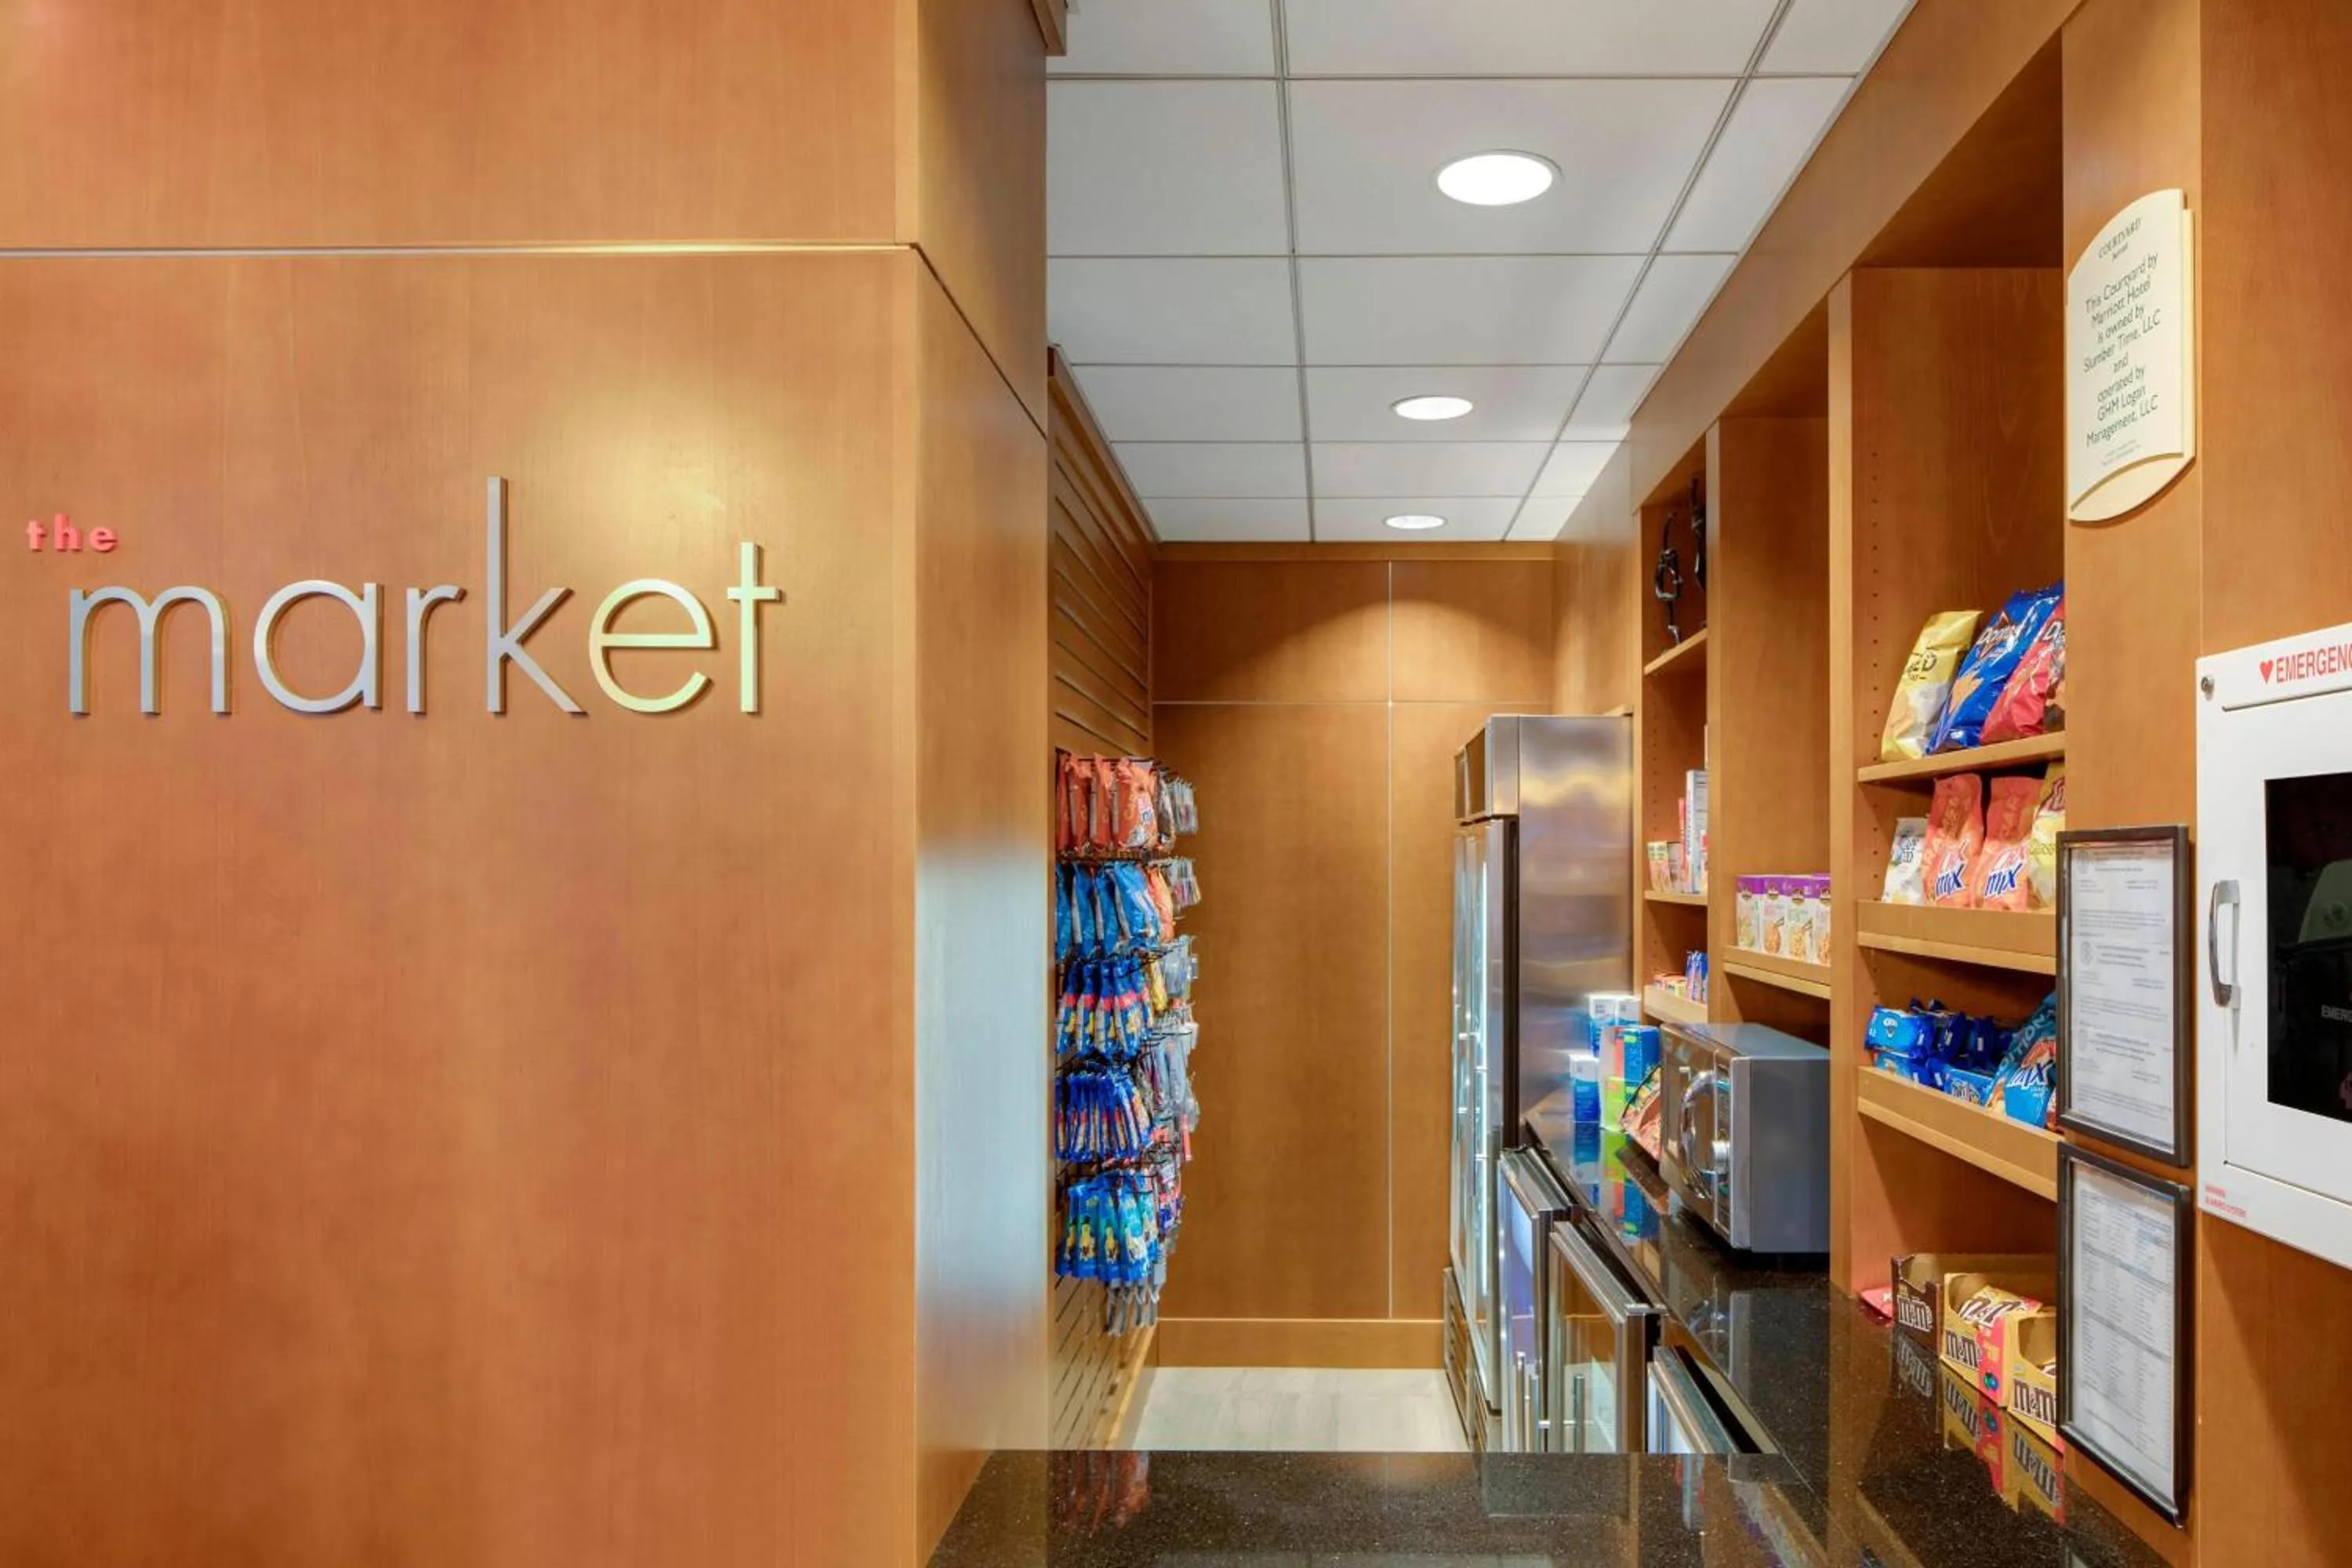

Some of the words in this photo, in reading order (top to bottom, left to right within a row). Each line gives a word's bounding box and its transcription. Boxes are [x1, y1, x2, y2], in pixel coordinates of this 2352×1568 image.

[2103, 258, 2146, 299] Courtyard
[2147, 252, 2158, 270] by
[2091, 297, 2125, 328] Marriott
[2126, 275, 2151, 304] Hotel
[2105, 308, 2133, 338] owned
[2135, 304, 2144, 321] by
[2143, 308, 2161, 334] LLC
[2114, 351, 2128, 373] and
[2097, 368, 2133, 405] operated
[2135, 364, 2145, 382] by
[2097, 396, 2119, 421] GHM
[2121, 386, 2146, 409] Logan
[2140, 394, 2158, 416] LLC
[26, 514, 118, 553] the
[70, 475, 783, 715] market
[2013, 1377, 2056, 1428] m&m
